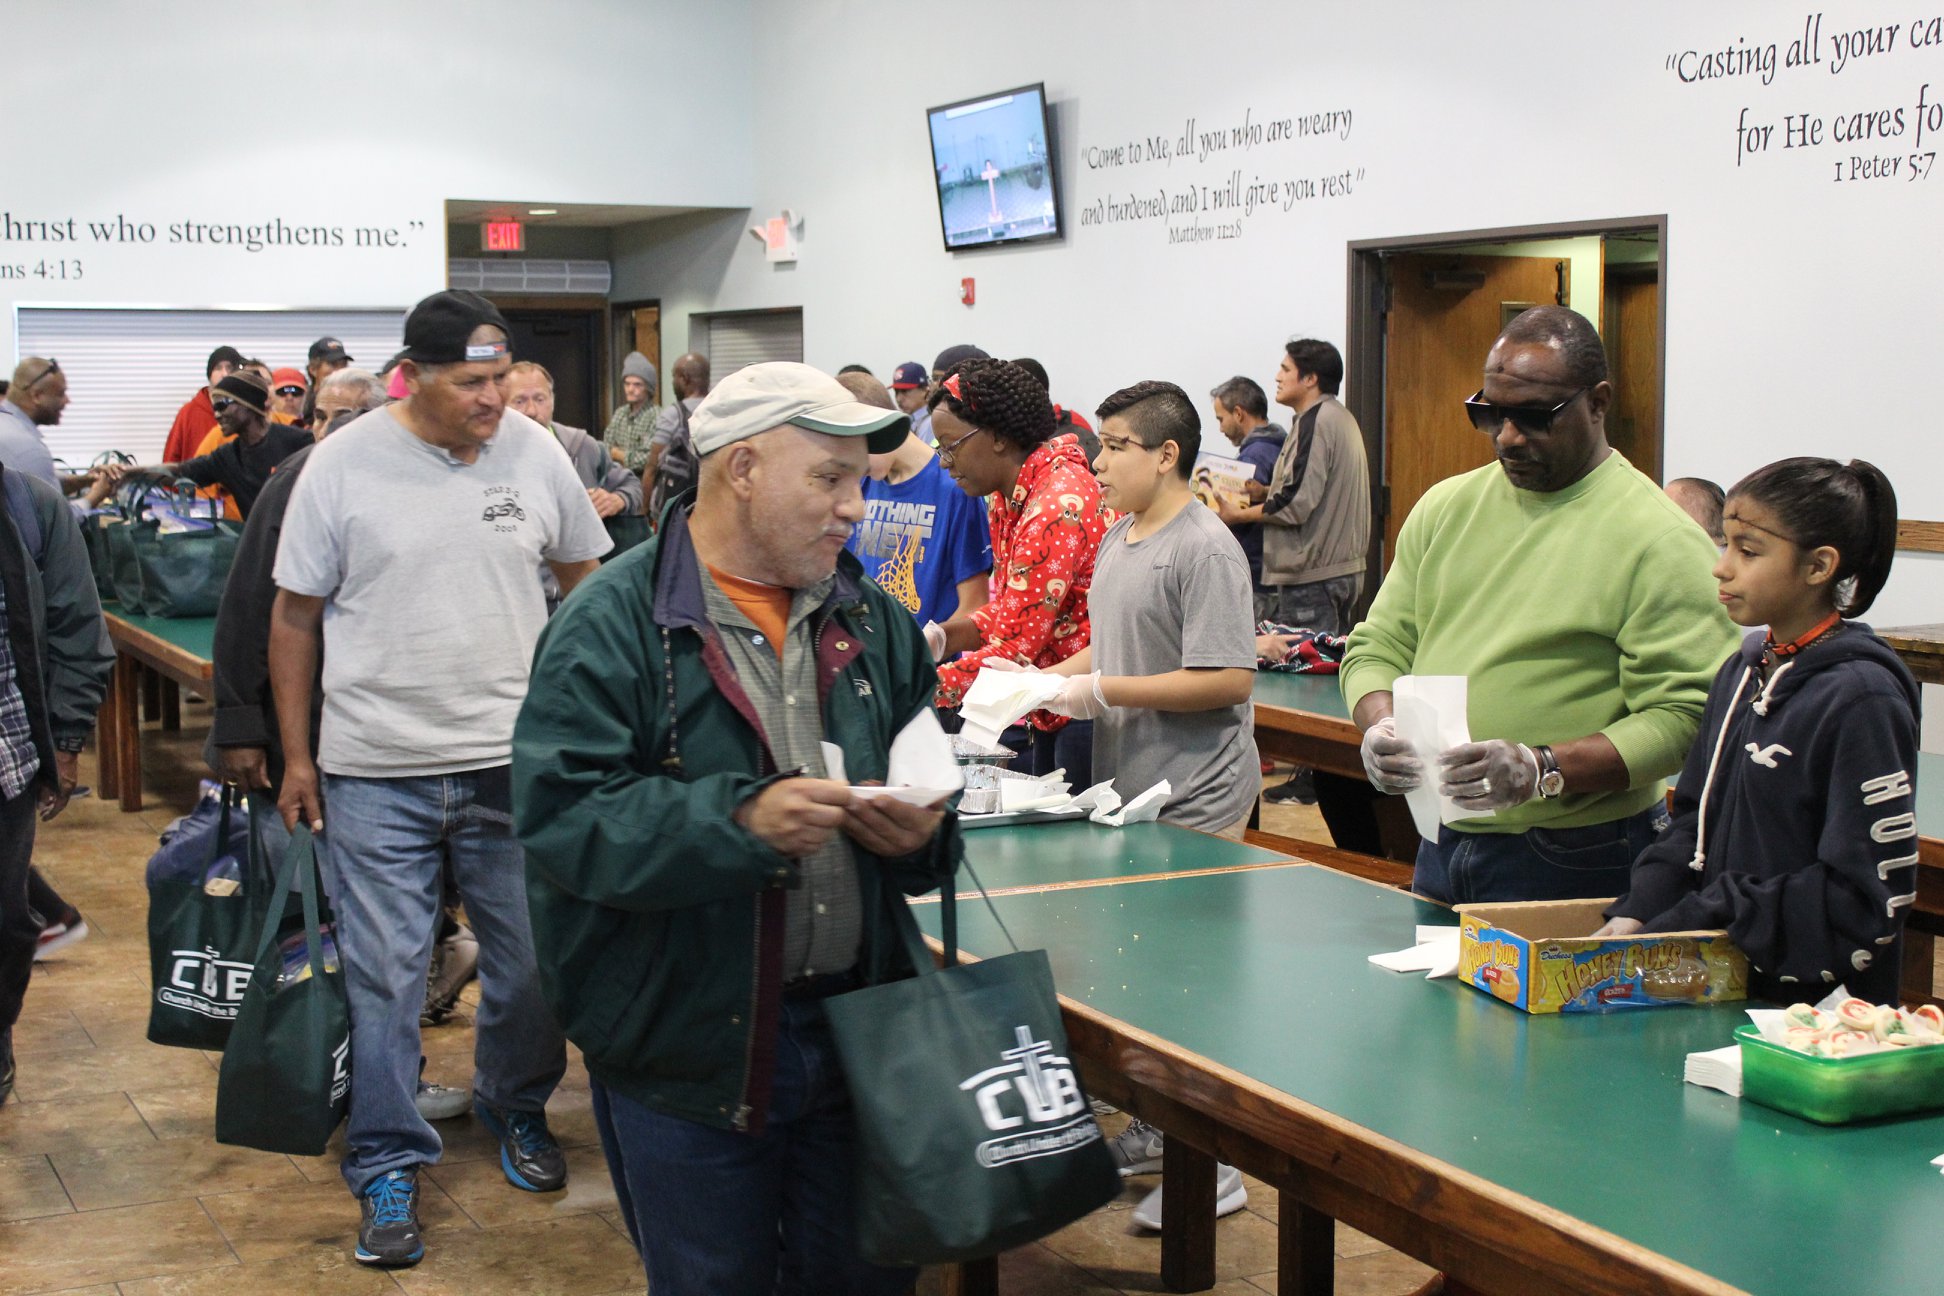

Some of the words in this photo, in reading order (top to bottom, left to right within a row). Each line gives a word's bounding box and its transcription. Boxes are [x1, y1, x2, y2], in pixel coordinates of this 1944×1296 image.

[1785, 13, 1822, 69] all
[1830, 24, 1900, 75] your
[1128, 141, 1142, 164] to
[1146, 135, 1172, 169] Me,
[1176, 117, 1195, 157] all
[1199, 129, 1227, 164] you
[1232, 107, 1262, 151] who
[1267, 118, 1292, 143] are
[1298, 108, 1352, 142] weary
[1736, 107, 1774, 167] for
[1784, 113, 1824, 149] He
[1833, 106, 1905, 143] cares
[1849, 155, 1902, 181] Peter
[1908, 151, 1936, 182] 5:7
[1081, 198, 1104, 227] and
[1171, 184, 1198, 214] and
[1201, 186, 1208, 212] I
[1213, 169, 1241, 211] will
[1245, 175, 1279, 217] give
[1284, 179, 1316, 213] you
[0, 212, 78, 243] hrist
[88, 213, 157, 244] who
[169, 218, 345, 253] strengthens
[486, 222, 521, 250] EXIT
[1169, 215, 1215, 245] Matthew
[33, 259, 84, 281] 4:13
[864, 499, 936, 527] OTHING
[1540, 950, 1573, 961] Duchess
